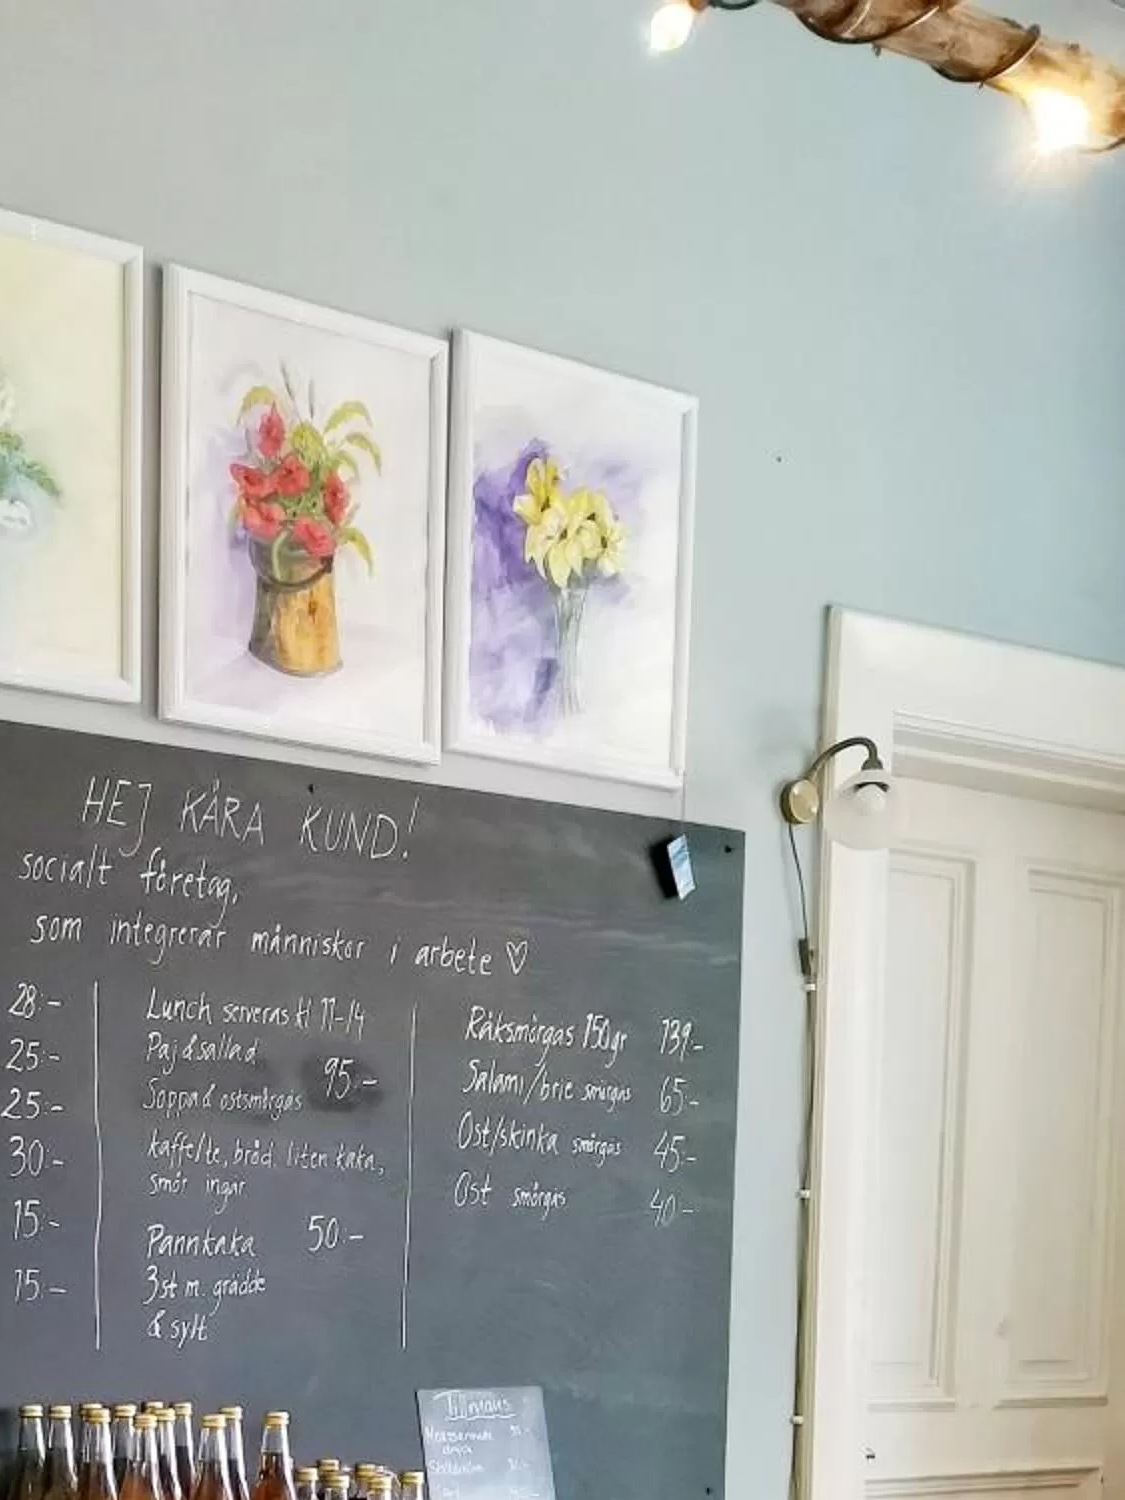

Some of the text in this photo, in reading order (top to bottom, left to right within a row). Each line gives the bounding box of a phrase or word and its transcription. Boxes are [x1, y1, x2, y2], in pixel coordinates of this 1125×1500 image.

[81, 776, 420, 860] HEJ KÄRA KUND!
[18, 845, 113, 889] socialt
[30, 910, 493, 976] som integrerar människor i arbete
[146, 985, 213, 1025] Lunch
[146, 1030, 178, 1076] Paj
[453, 1171, 493, 1208] Ost
[146, 1223, 257, 1260] Pannkaka
[170, 1312, 209, 1349] sylt
